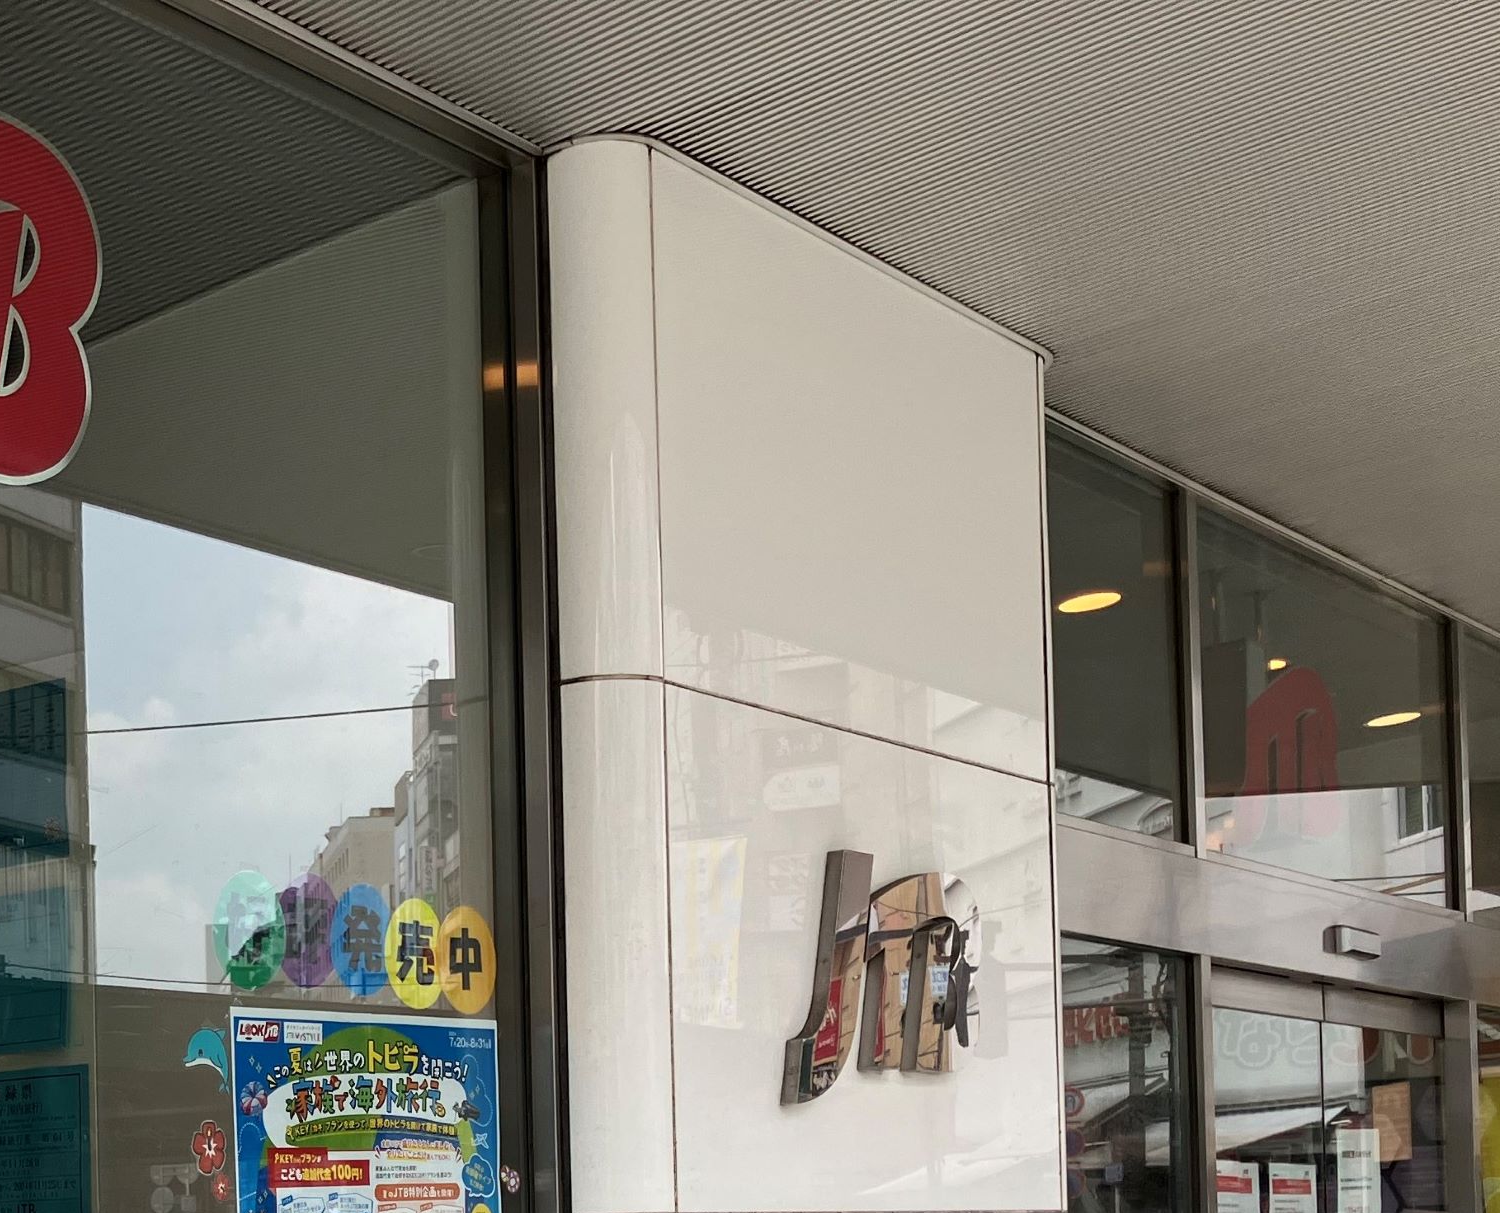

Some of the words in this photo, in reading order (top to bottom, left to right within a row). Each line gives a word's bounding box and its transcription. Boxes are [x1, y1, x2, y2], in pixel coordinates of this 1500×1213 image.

[285, 1074, 443, 1122] 家族で海外旅行
